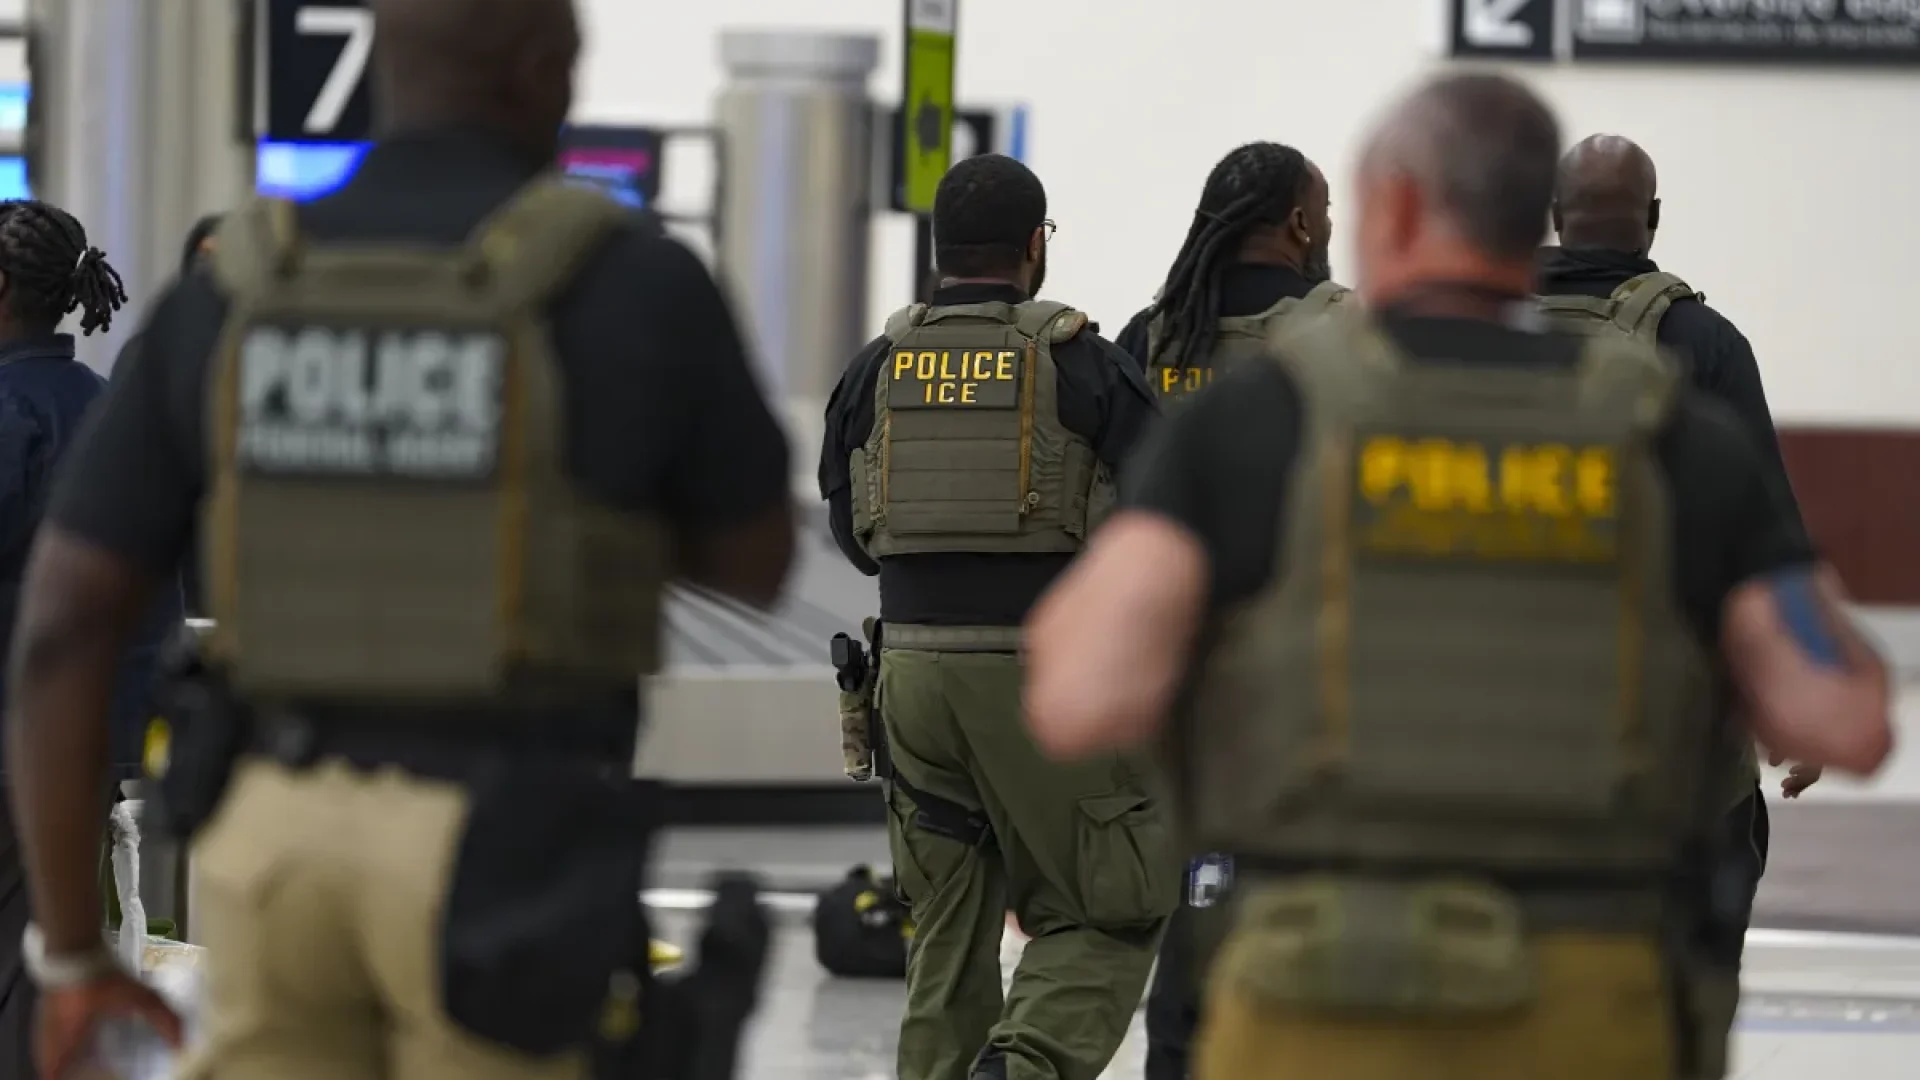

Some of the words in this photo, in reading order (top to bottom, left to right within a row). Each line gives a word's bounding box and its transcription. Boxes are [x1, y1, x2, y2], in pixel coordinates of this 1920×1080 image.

[295, 7, 375, 133] 7
[242, 328, 504, 428] POLICE
[894, 351, 1015, 380] POLICE
[926, 383, 978, 403] ICE
[1361, 437, 1613, 517] POLICE
